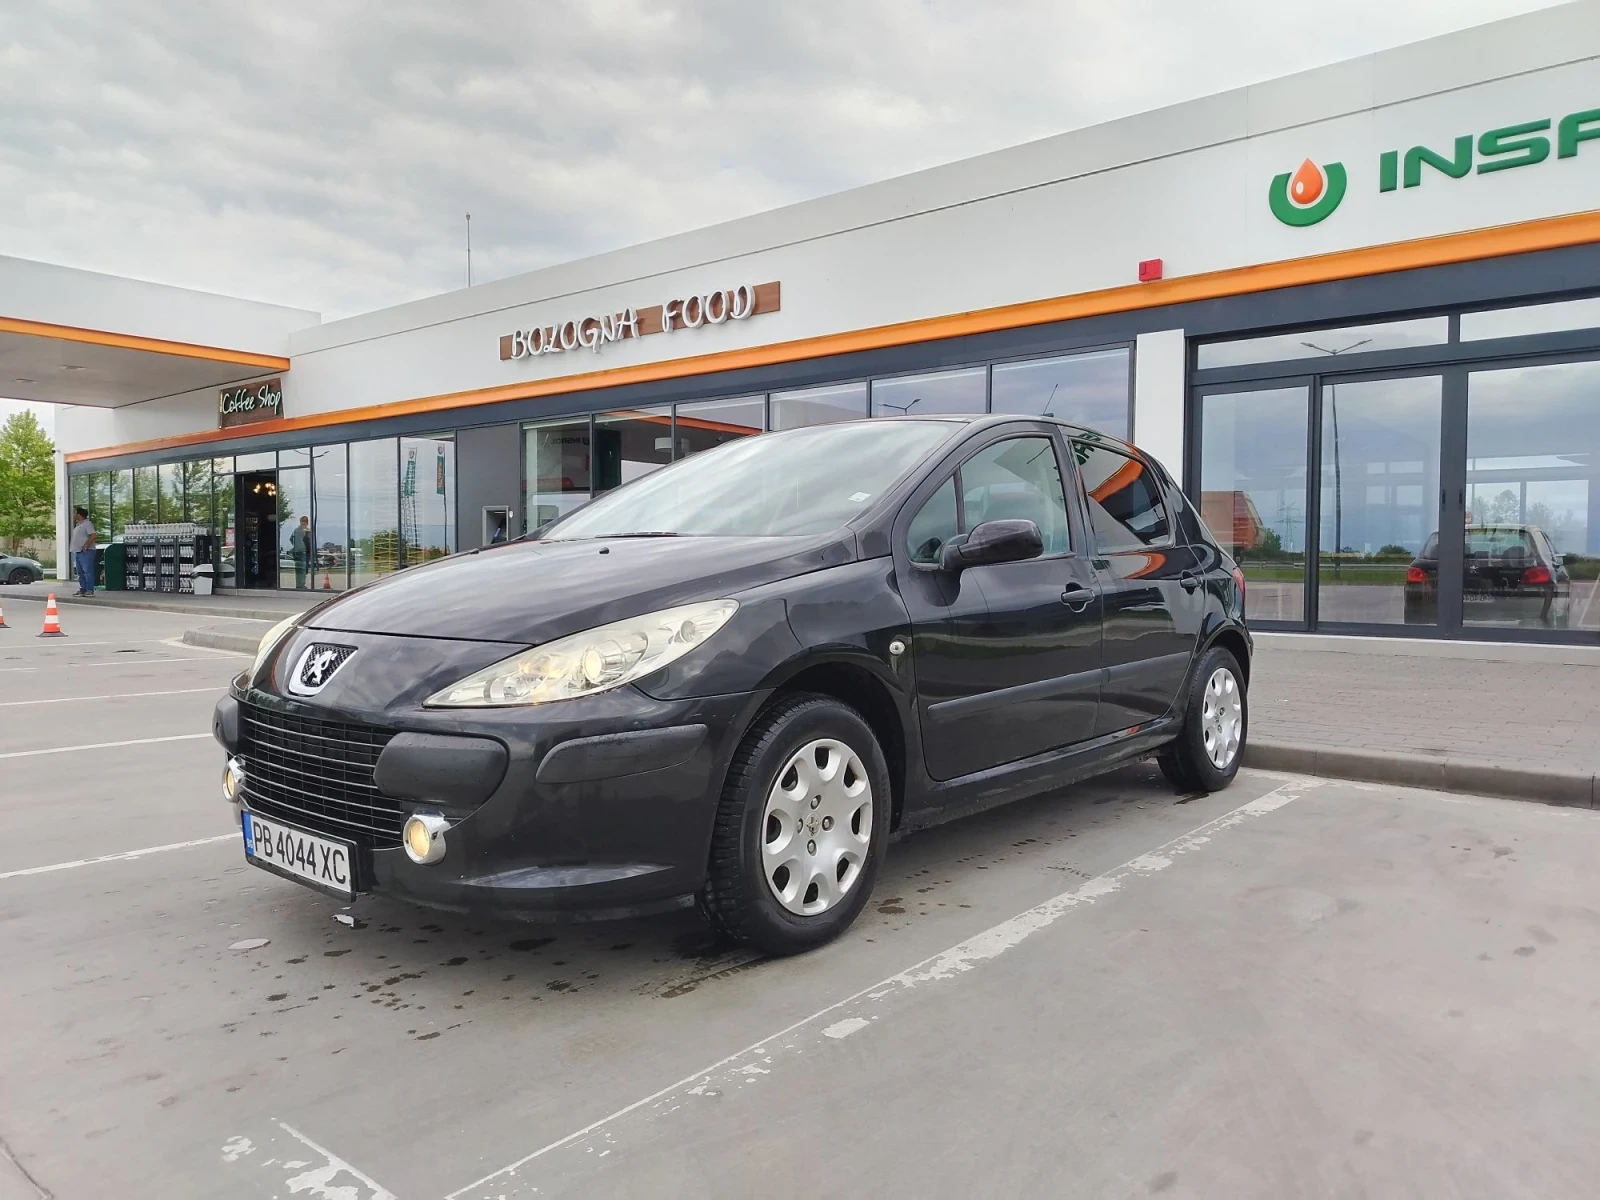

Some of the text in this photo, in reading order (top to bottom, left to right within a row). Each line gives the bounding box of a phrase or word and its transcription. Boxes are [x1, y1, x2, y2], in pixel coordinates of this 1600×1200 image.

[511, 285, 755, 360] BOLOGNA FOOD
[222, 384, 281, 415] Coffee Shop
[276, 831, 317, 875] 4044
